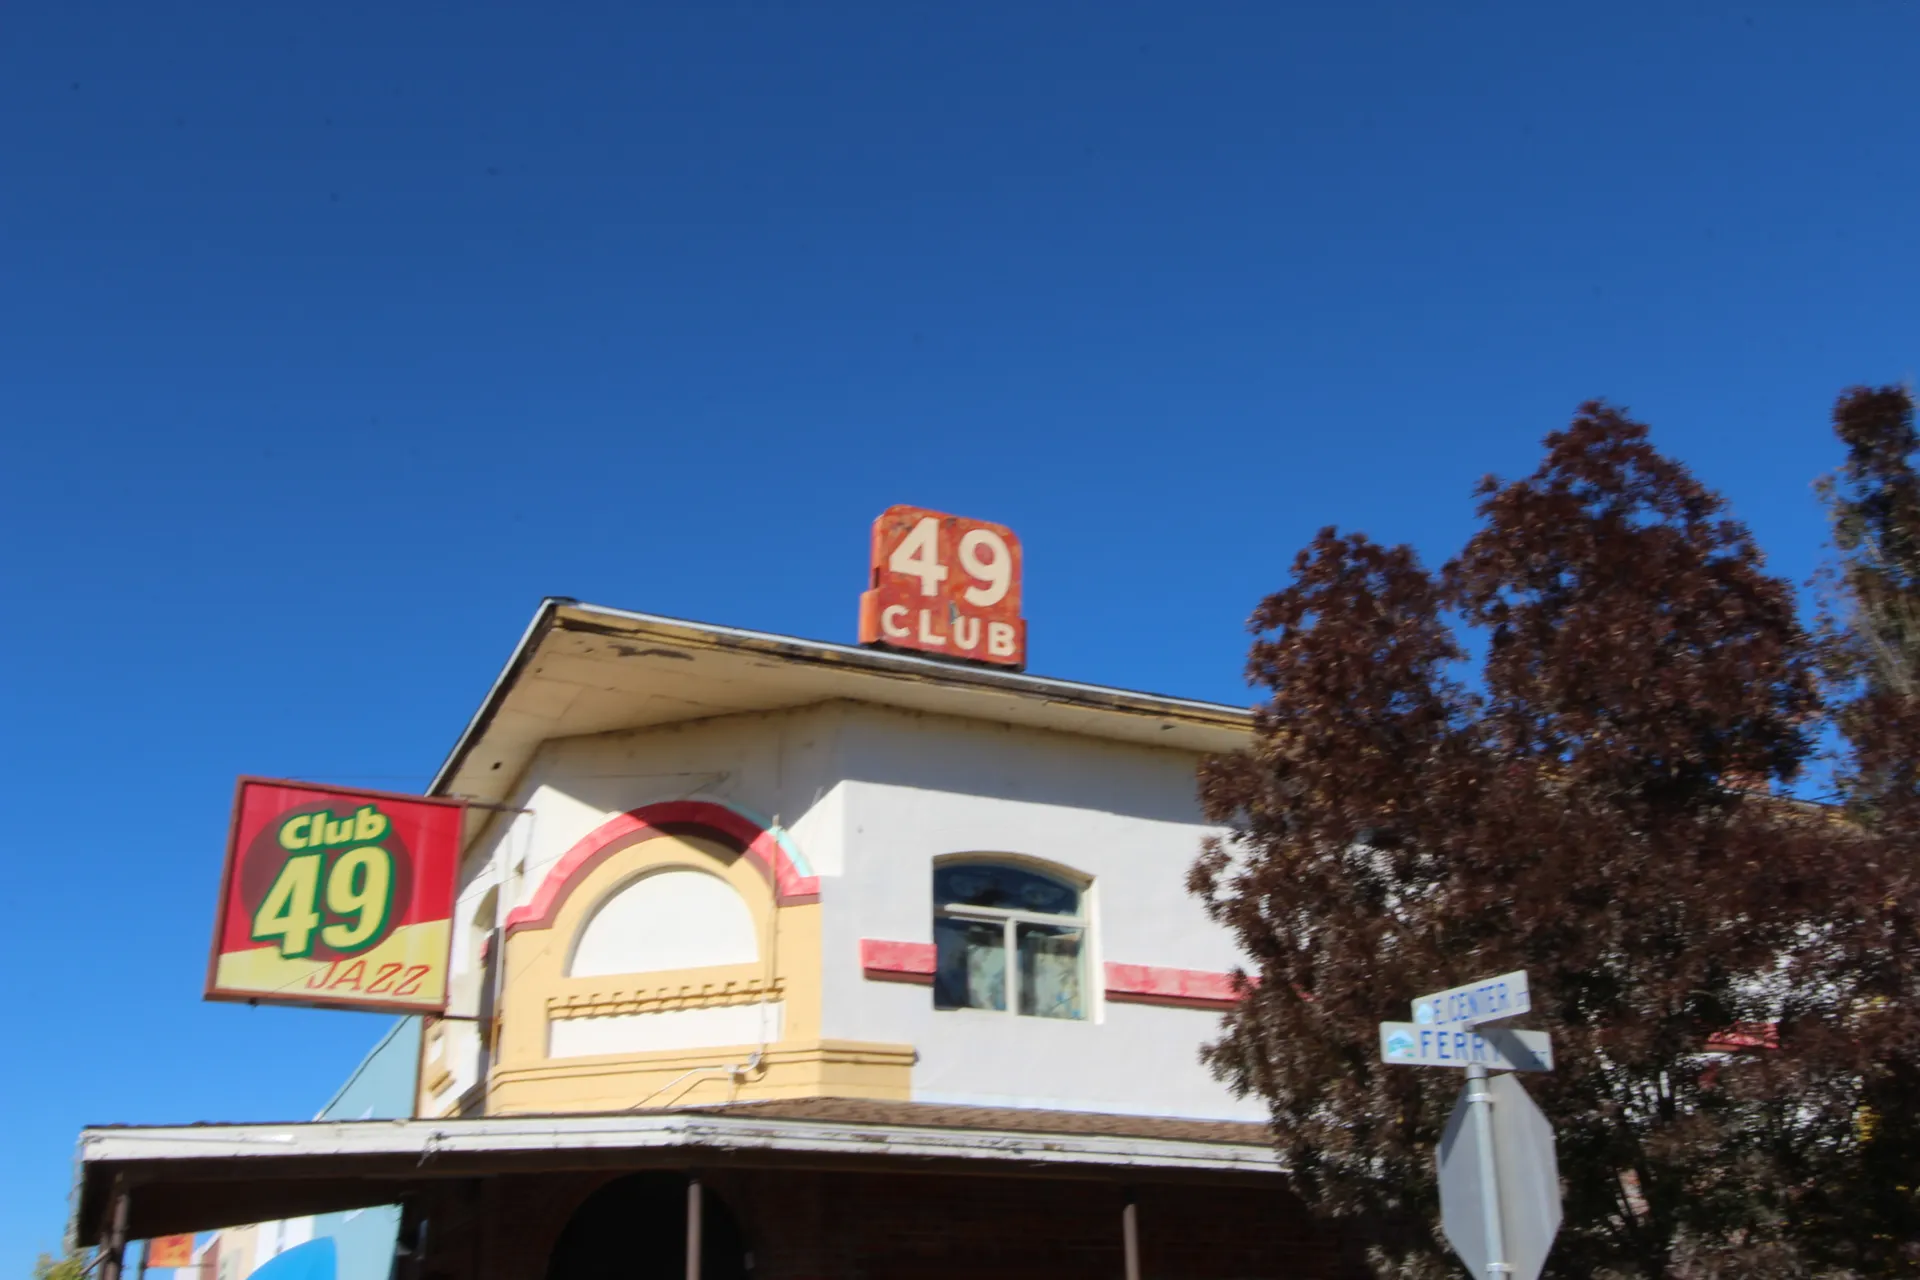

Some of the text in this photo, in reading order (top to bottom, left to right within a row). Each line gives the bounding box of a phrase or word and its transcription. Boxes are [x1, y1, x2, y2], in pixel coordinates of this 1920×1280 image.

[889, 517, 1012, 607] 49
[881, 604, 1016, 656] CLUB
[278, 805, 390, 851] Club
[251, 846, 392, 957] 49
[305, 959, 431, 996] JAZZ
